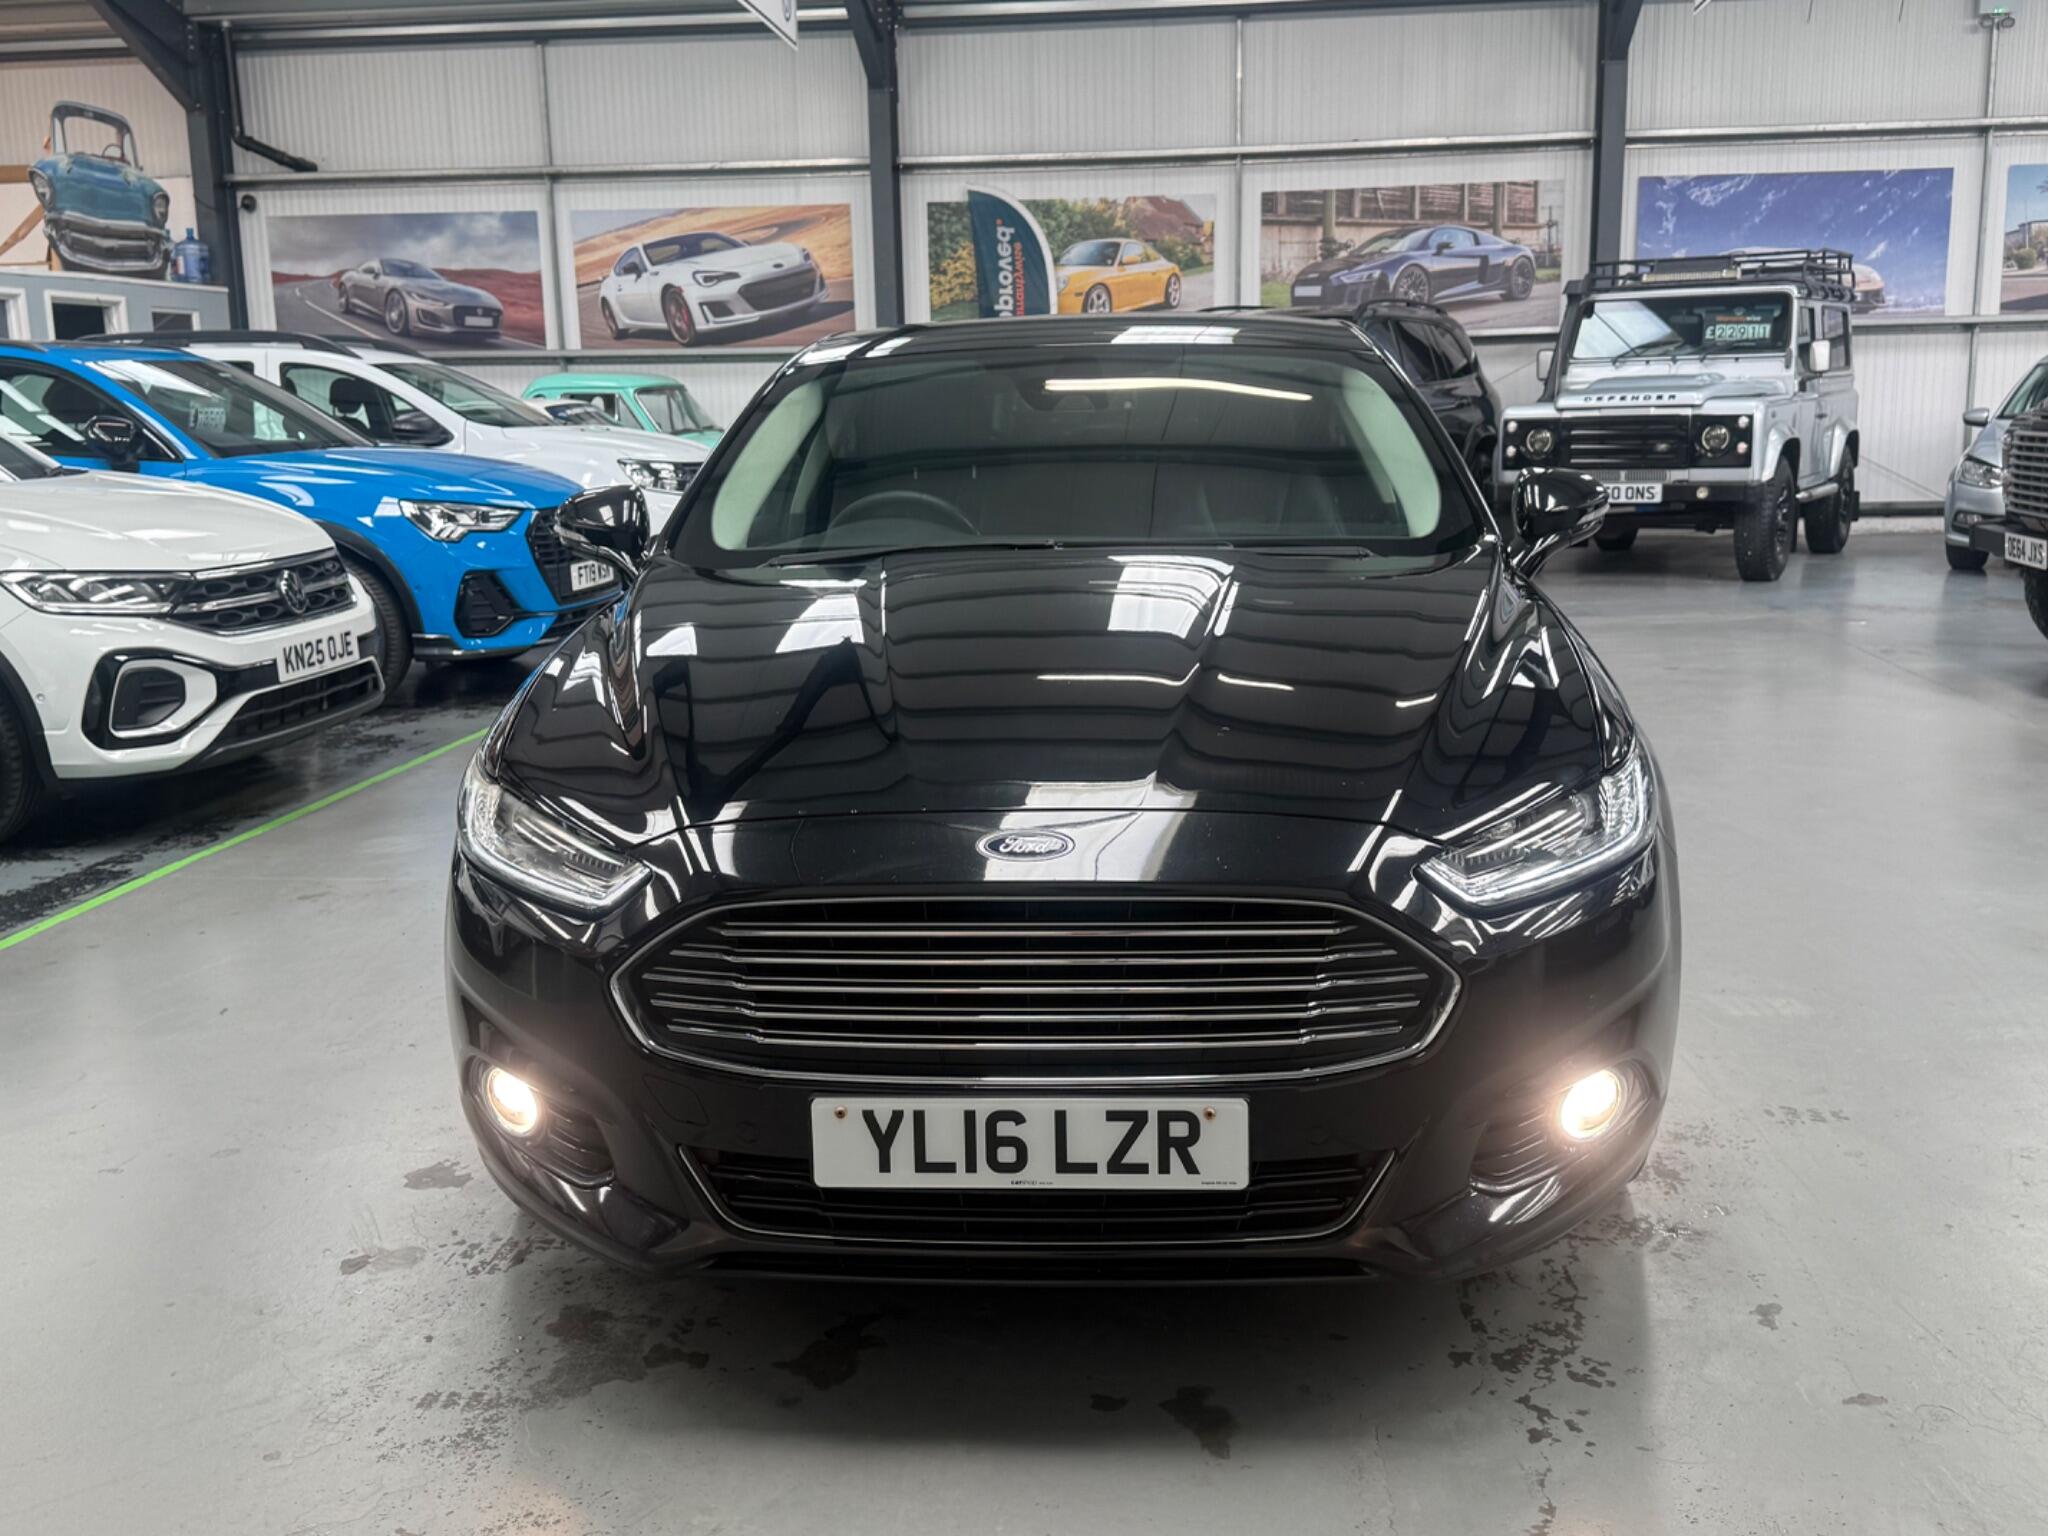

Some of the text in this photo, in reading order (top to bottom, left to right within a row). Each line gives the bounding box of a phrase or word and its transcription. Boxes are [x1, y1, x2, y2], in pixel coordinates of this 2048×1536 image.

[1584, 393, 1677, 402] DEFENDER
[1625, 486, 1656, 500] ONS
[283, 631, 354, 674] KN25 OJE
[999, 835, 1058, 853] Ford
[861, 1109, 1201, 1175] YL16 LZR
